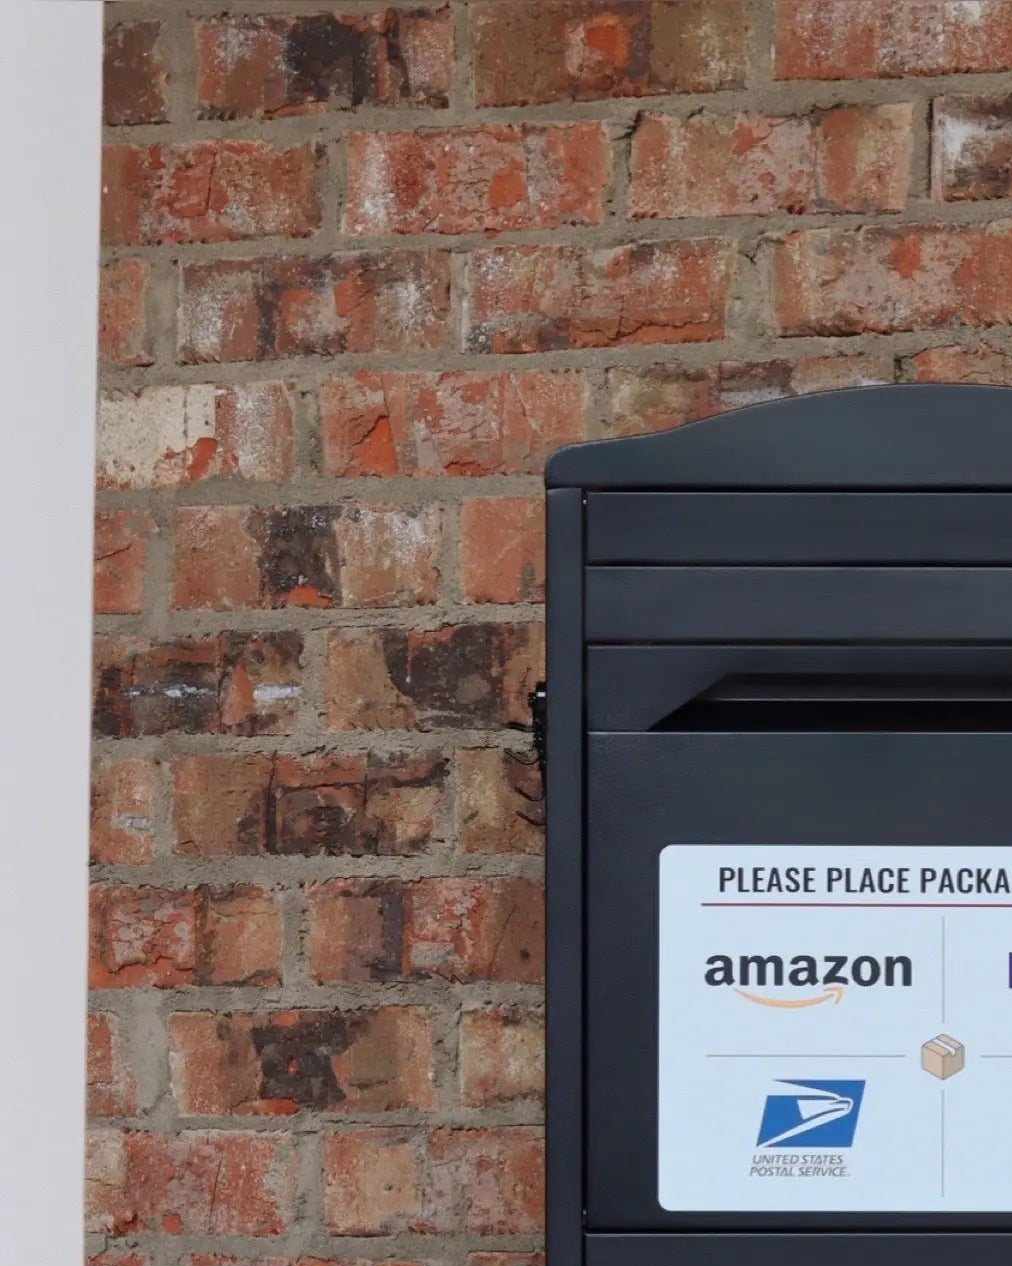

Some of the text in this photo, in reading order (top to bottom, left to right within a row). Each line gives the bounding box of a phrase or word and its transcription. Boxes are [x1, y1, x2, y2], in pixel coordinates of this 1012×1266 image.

[719, 867, 816, 893] PLEASE
[826, 867, 910, 894] PLACE
[704, 955, 913, 988] amazon
[752, 1155, 844, 1165] UNITED STATES
[750, 1166, 794, 1177] POSTAL
